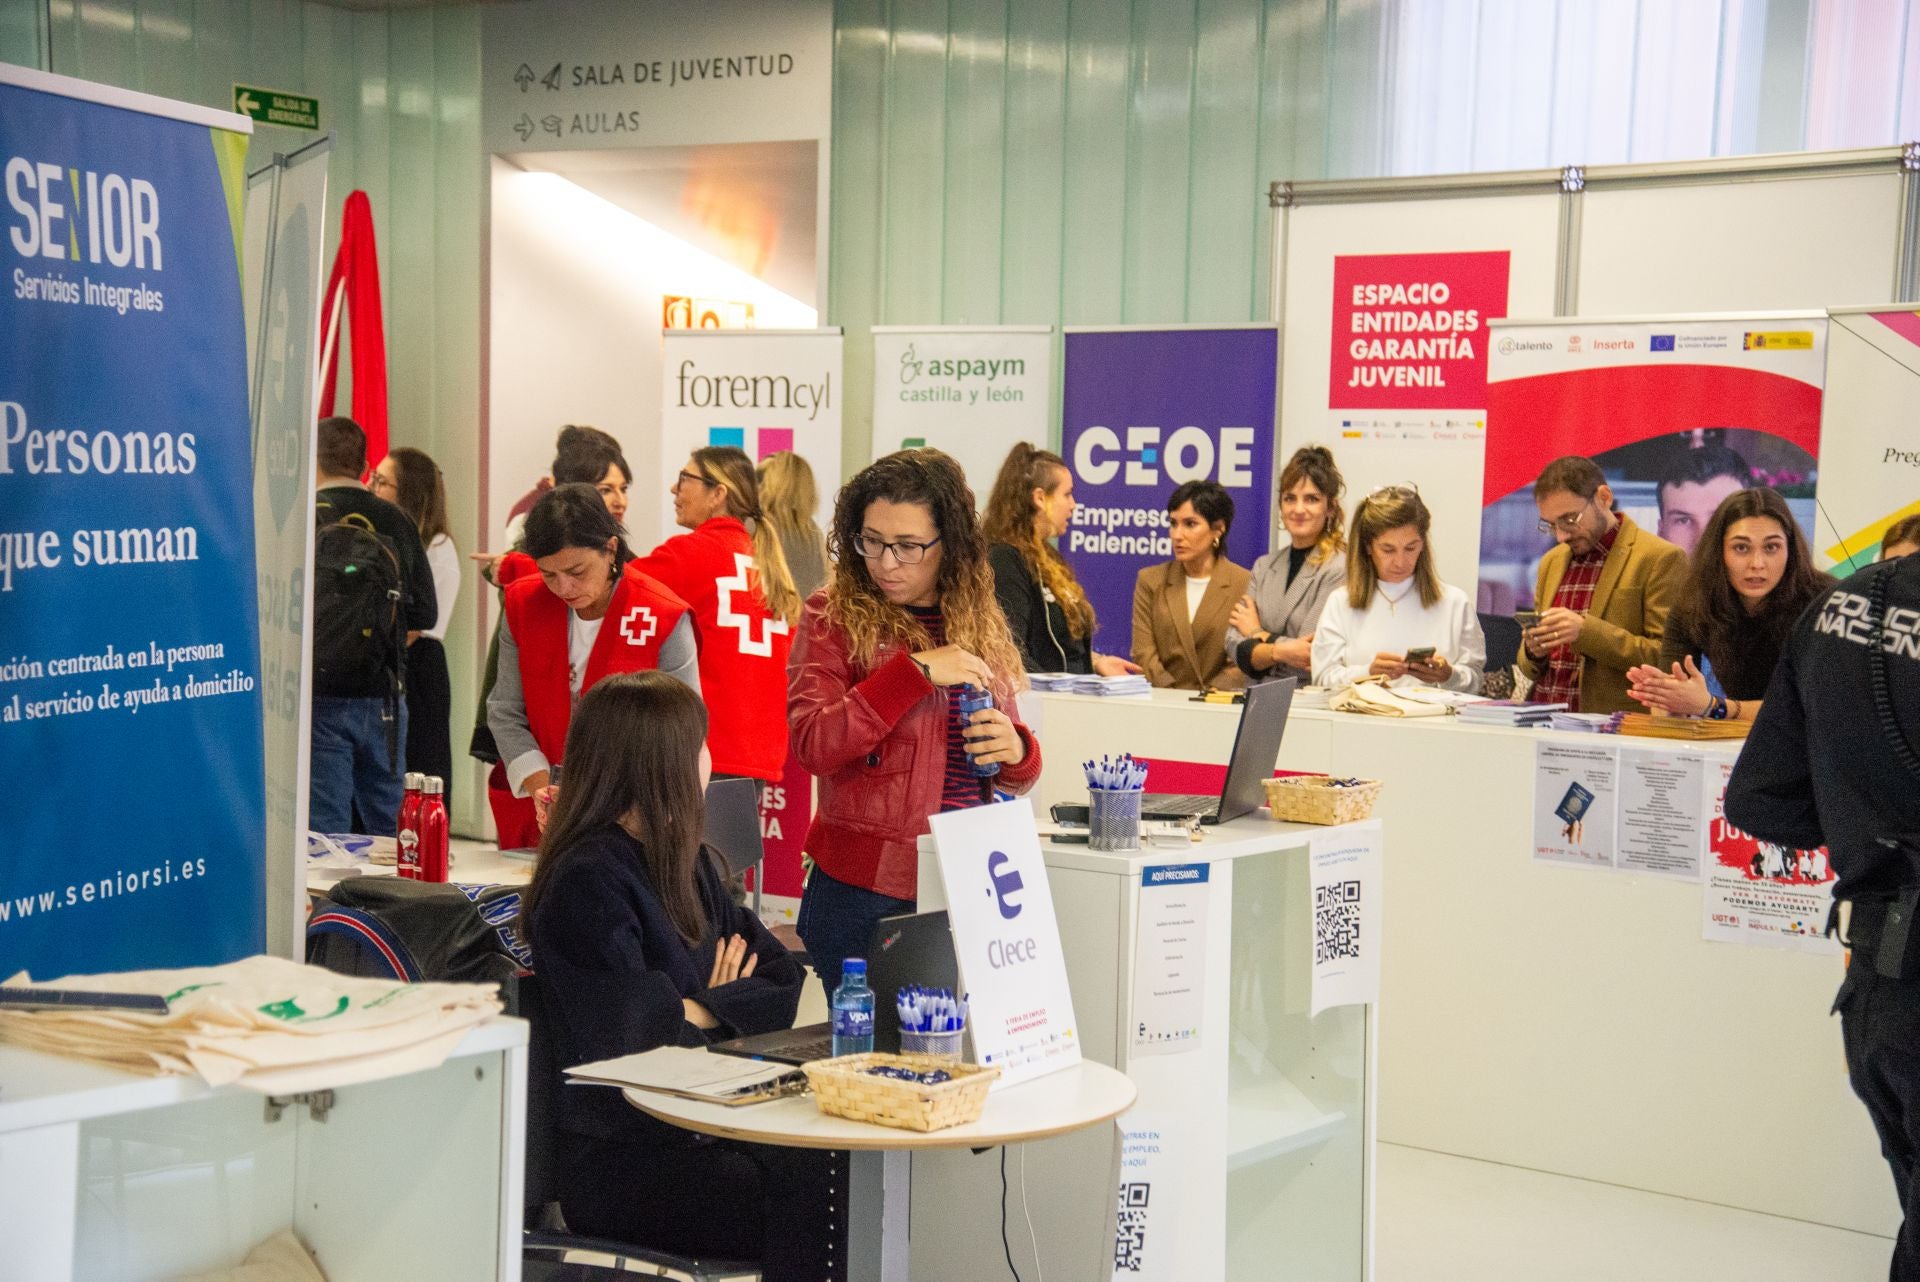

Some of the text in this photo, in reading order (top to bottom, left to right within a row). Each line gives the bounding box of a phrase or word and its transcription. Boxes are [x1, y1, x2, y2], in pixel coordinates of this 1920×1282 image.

[572, 54, 795, 87] SALA DE JUVENTUD
[570, 111, 641, 135] AULAS
[5, 156, 162, 271] SENIOR
[13, 267, 164, 315] Servicios Integrales
[1353, 282, 1450, 306] ESPACIO
[1351, 310, 1479, 333] ENTIDADES
[1350, 332, 1475, 360] GARANTÍA
[1593, 339, 1635, 350] Inserta
[928, 358, 1025, 381] aspaym
[1348, 366, 1445, 388] JUVENIL
[677, 360, 831, 422] foremcyl
[899, 385, 1024, 405] castilla y león
[0, 401, 196, 475] Personas
[1074, 426, 1255, 488] CEOE
[1070, 530, 1172, 556] Palencia
[0, 526, 199, 591] que suman
[0, 640, 224, 682] ción centrada en la persona
[3, 669, 254, 723] al servicio de ayuda a domicilio
[1152, 869, 1165, 882] AQUÍ
[1712, 914, 1728, 923] UGT
[1723, 896, 1767, 907] PODEMOS
[1771, 902, 1820, 914] AYUDARTE
[988, 937, 1036, 970] Clece
